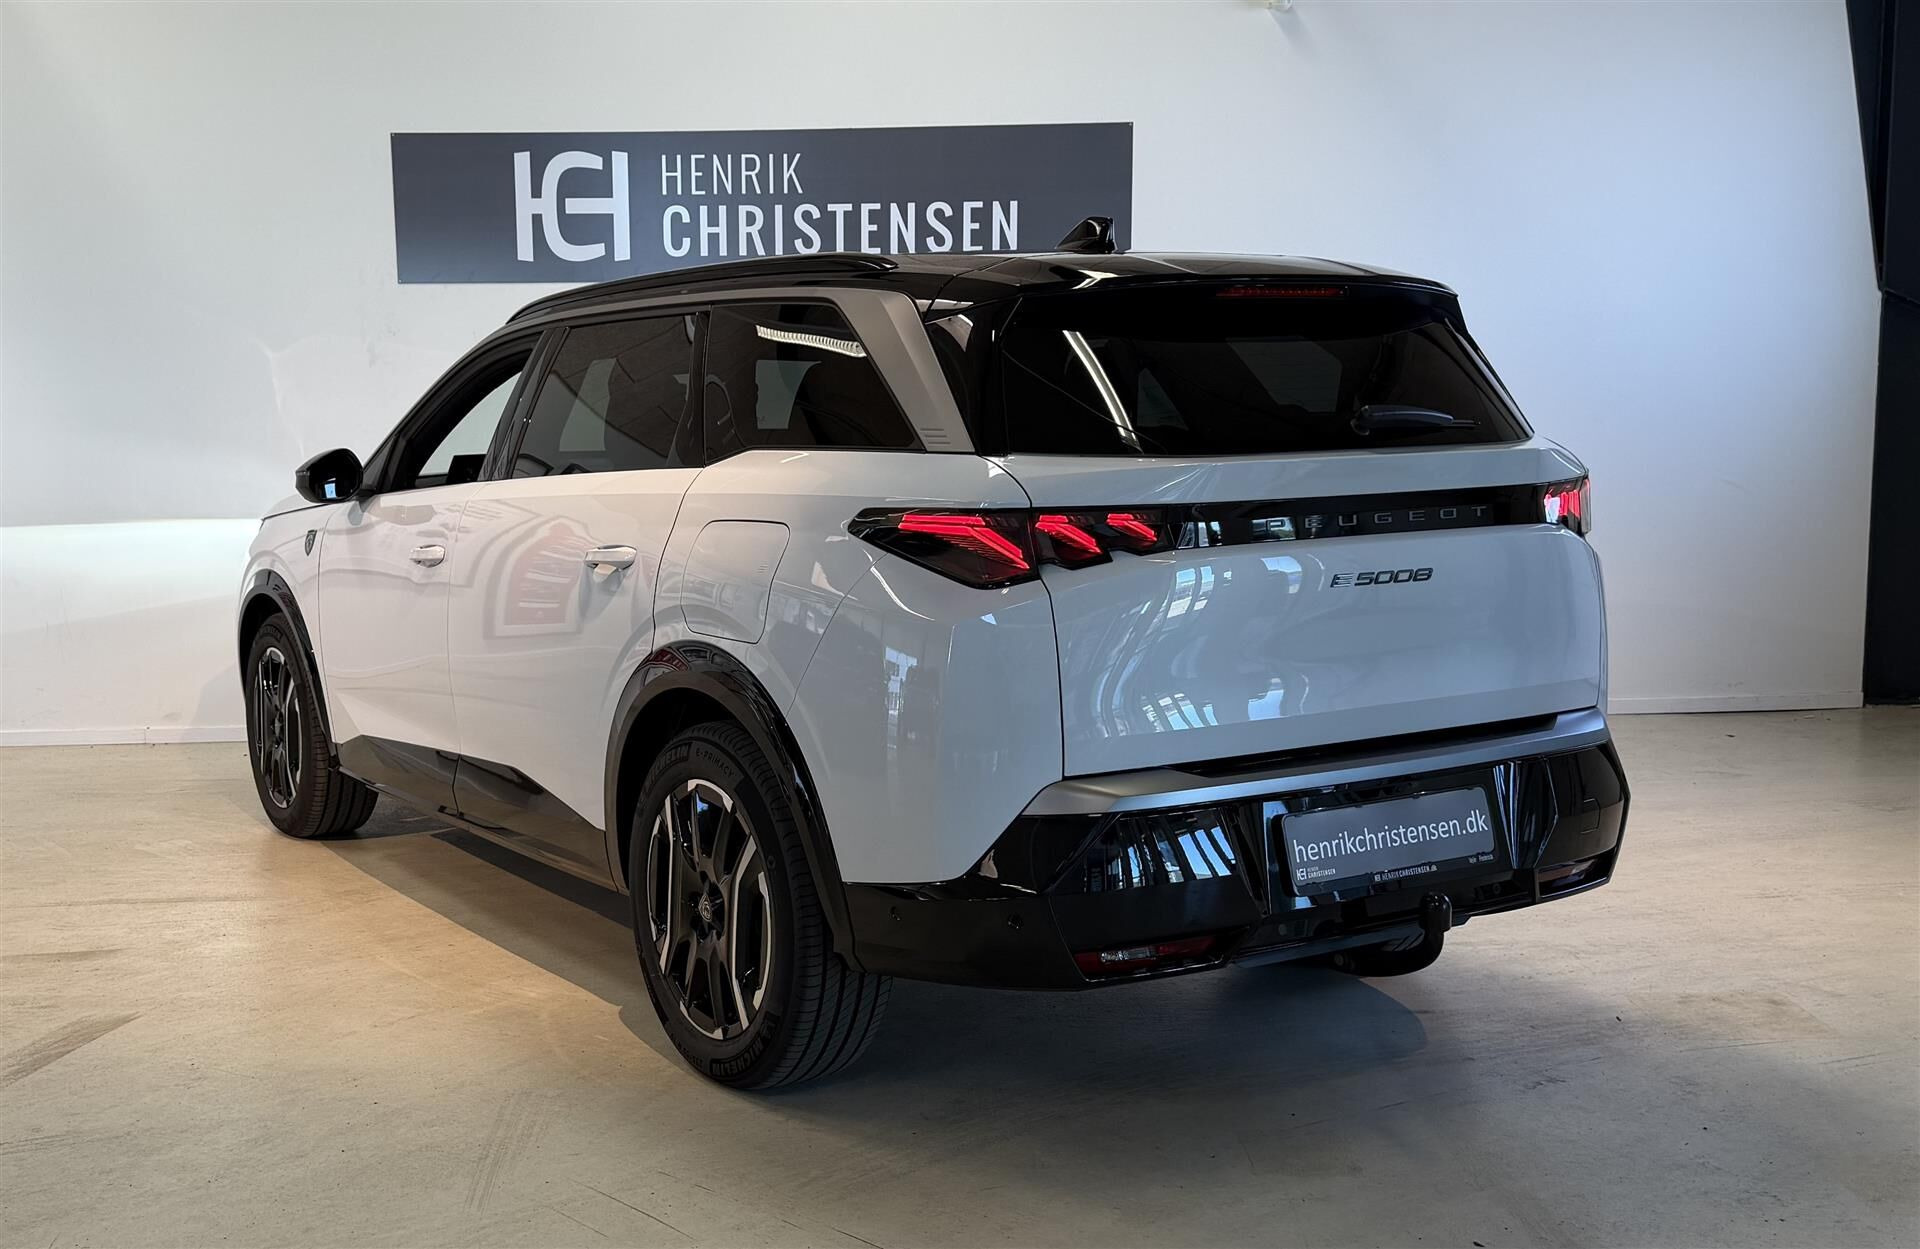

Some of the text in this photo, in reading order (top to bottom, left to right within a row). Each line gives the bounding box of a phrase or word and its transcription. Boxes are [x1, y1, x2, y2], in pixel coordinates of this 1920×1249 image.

[660, 152, 803, 196] HENRIK
[662, 199, 1019, 257] CHRISTENSEN
[1266, 505, 1488, 531] PEUGEOT
[1293, 809, 1489, 863] henrikchristensen.dk
[1307, 868, 1336, 879] CHRISTENSEN
